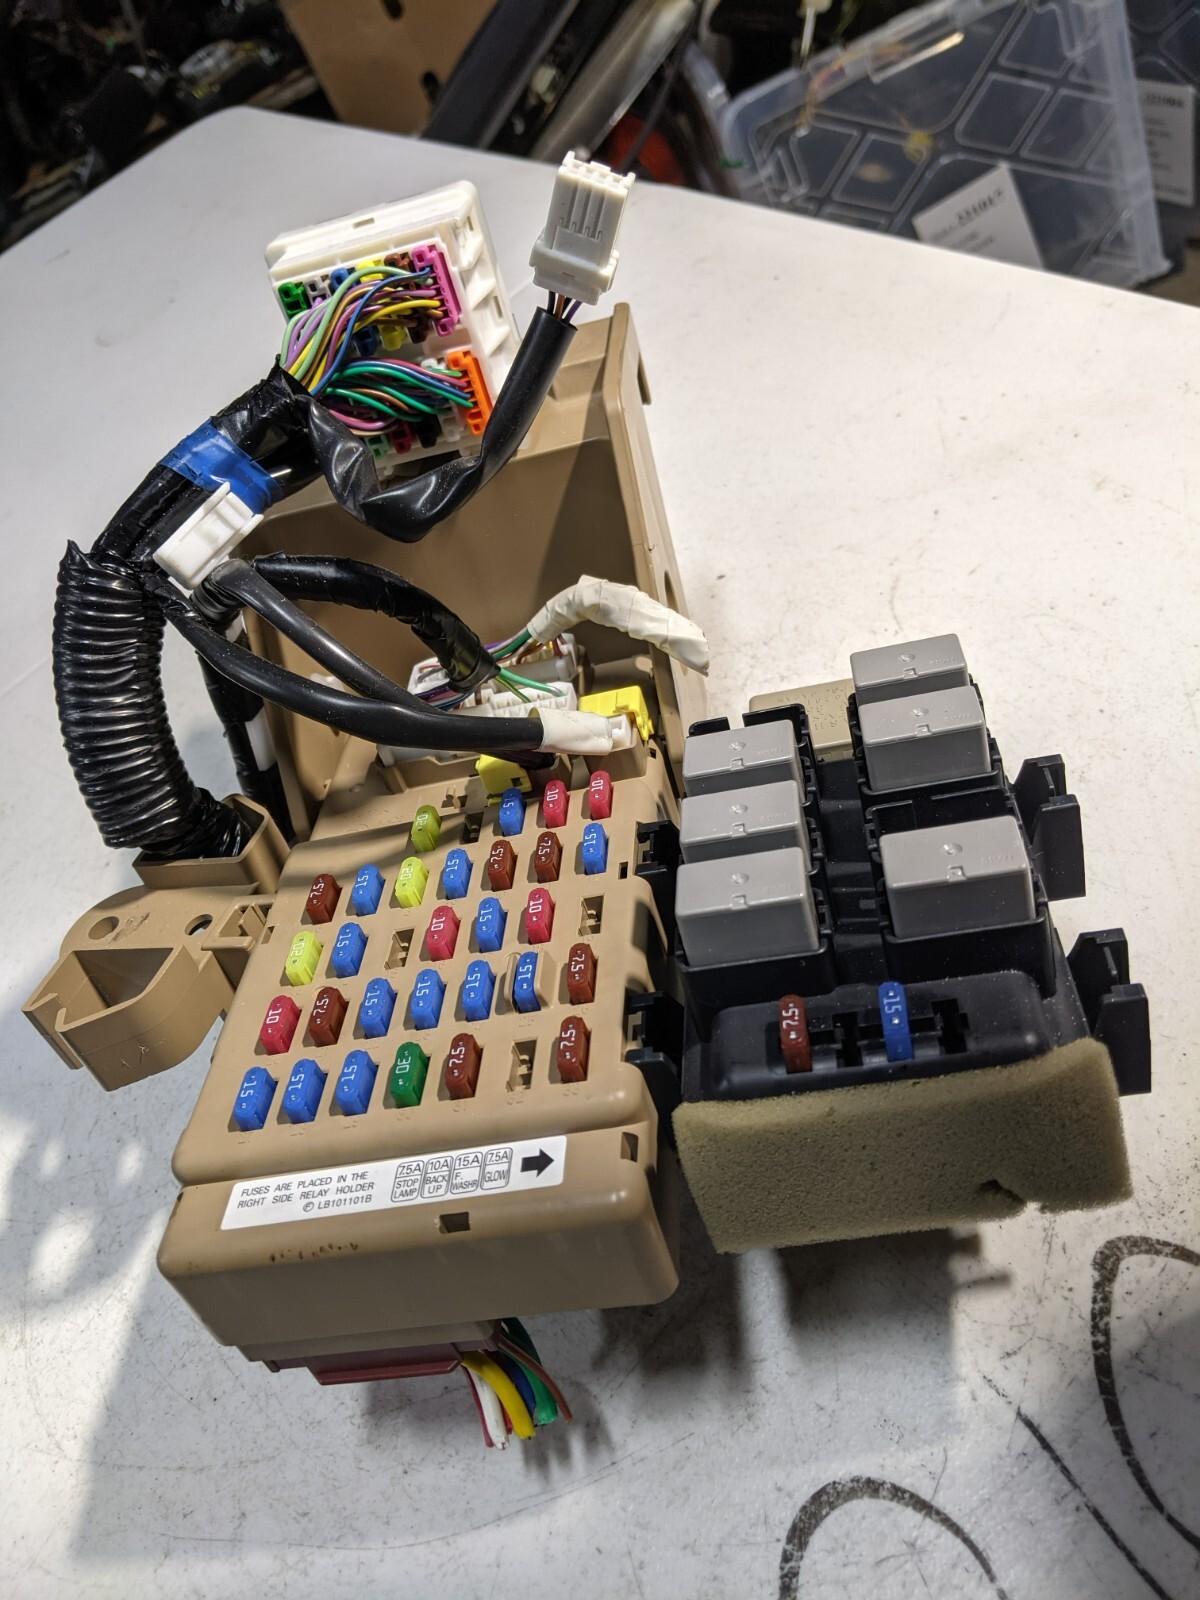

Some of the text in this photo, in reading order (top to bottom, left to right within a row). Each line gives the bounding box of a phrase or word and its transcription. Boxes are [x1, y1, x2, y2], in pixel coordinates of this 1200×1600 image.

[591, 779, 604, 792] 10
[547, 788, 558, 801] 10
[538, 840, 552, 855] 7.5
[584, 833, 597, 846] 15
[490, 848, 504, 863] 7.5
[446, 859, 459, 872] 15
[355, 874, 369, 888] 15
[400, 868, 414, 880] 20
[310, 882, 324, 898] 7.5
[528, 898, 543, 914] 10
[479, 907, 493, 922] 15
[430, 916, 446, 932] 10
[336, 932, 352, 948] 15
[290, 942, 305, 957] 20
[570, 953, 586, 972] 7.5
[466, 972, 481, 989] 15
[518, 964, 532, 981] 15
[416, 980, 432, 997] 15
[364, 990, 380, 1006] 15
[883, 996, 902, 1014] 15
[312, 998, 329, 1016] 7.5
[266, 1008, 282, 1024] 10
[782, 1008, 800, 1030] 7.5
[560, 1028, 576, 1050] 7.5
[448, 1046, 466, 1067] 7.5
[341, 1064, 358, 1082] 15
[396, 1056, 412, 1074] 30
[240, 1080, 258, 1098] 15
[288, 1073, 305, 1090] 15
[458, 1155, 480, 1167] 15A
[488, 1150, 509, 1163] 7.5A
[398, 1163, 422, 1176] 7.5A
[429, 1159, 449, 1171] 10A
[240, 1171, 368, 1197] FUSES ARE PLACED IN THE
[396, 1178, 419, 1190] STOP
[425, 1174, 448, 1184] BACK
[454, 1172, 463, 1180] F.
[484, 1170, 508, 1182] GLOW
[428, 1185, 442, 1194] UP
[451, 1180, 478, 1190] WASHR
[237, 1182, 374, 1208] RIGHT SIDE RELAY HOLDER
[394, 1188, 417, 1199] LAMP
[318, 1194, 372, 1210] LB101101B
